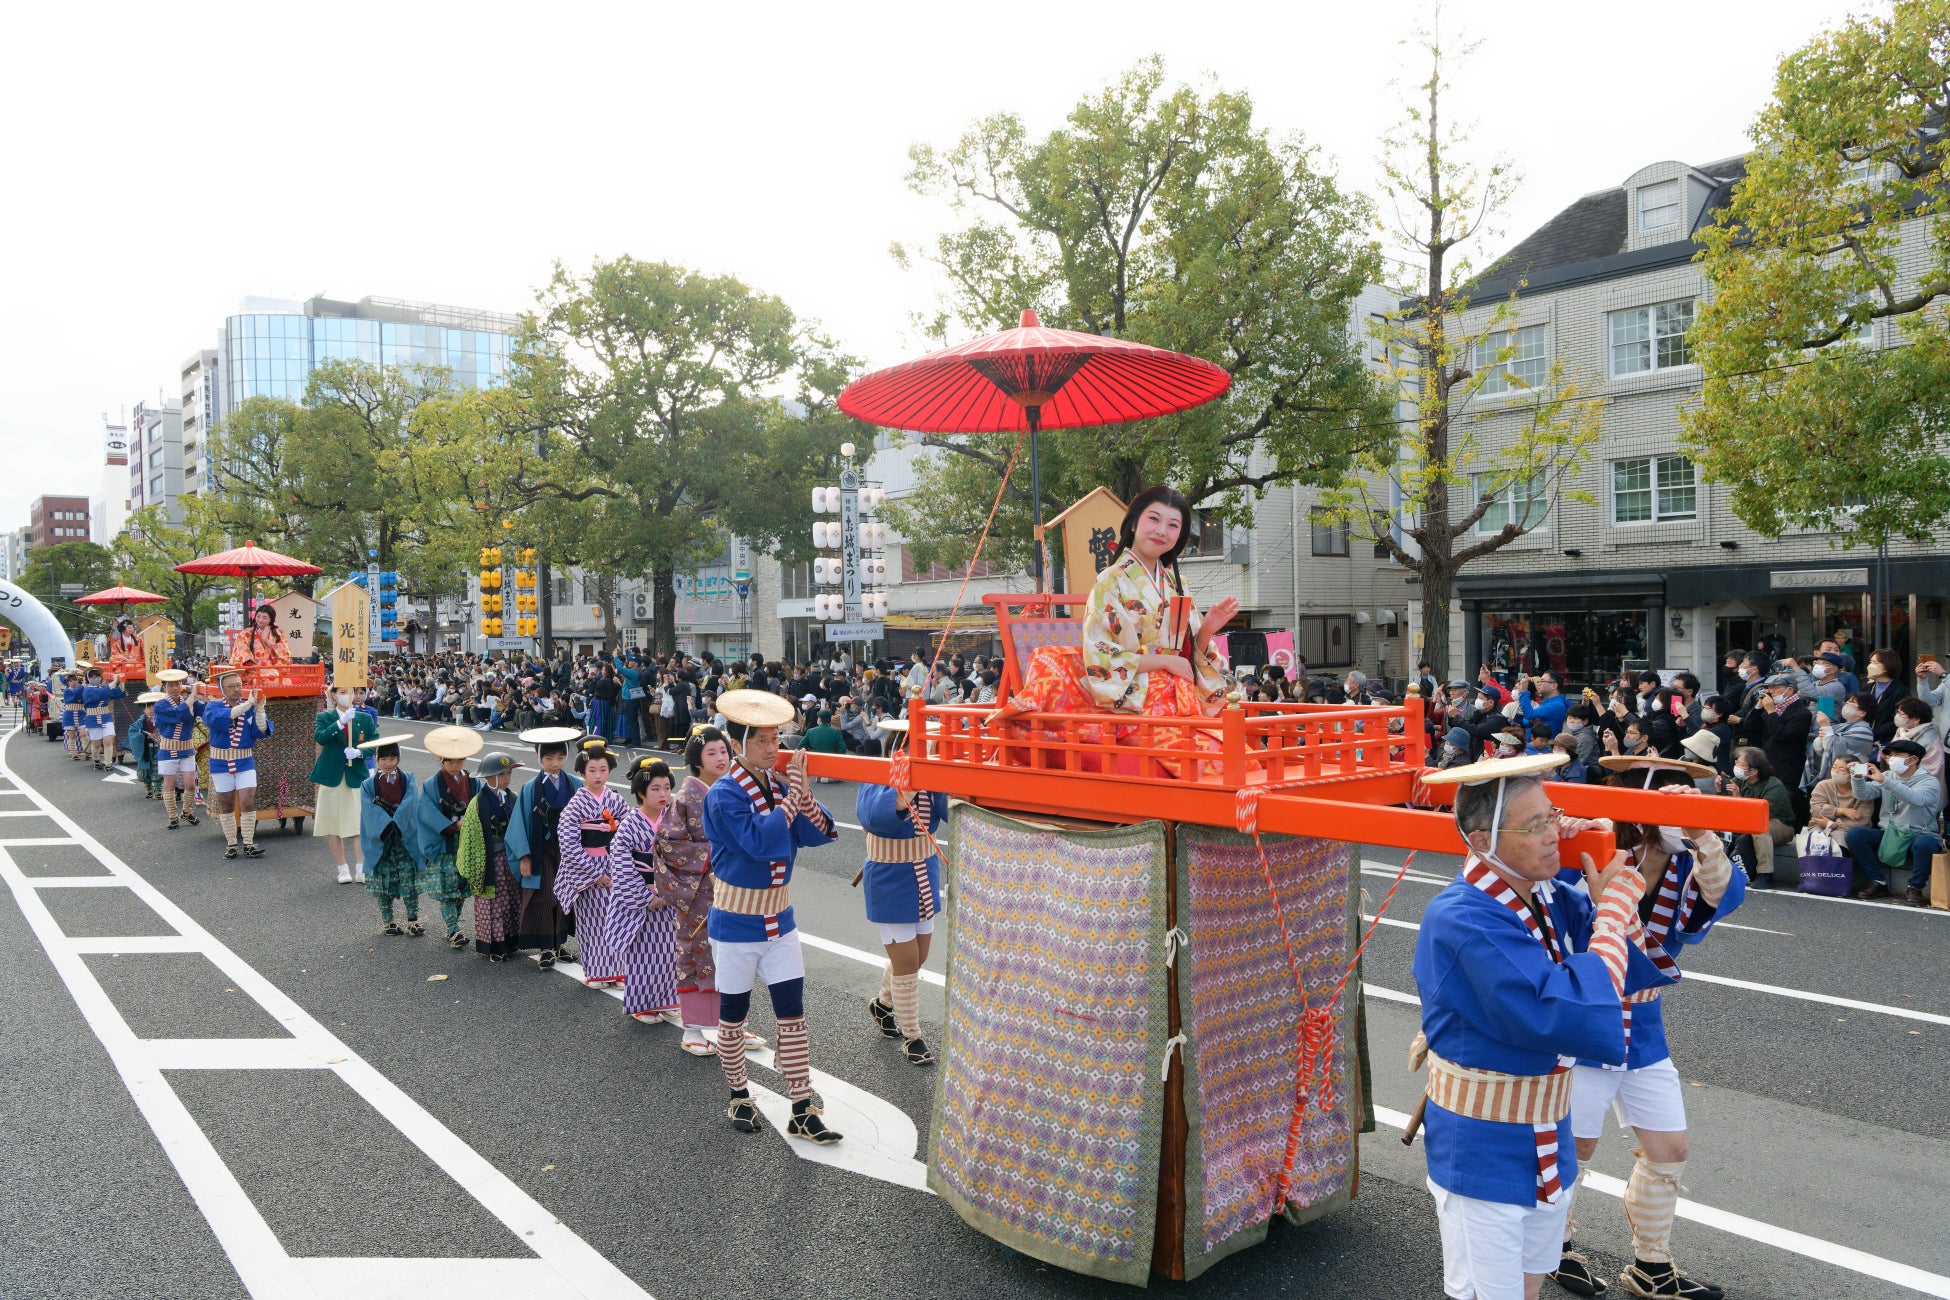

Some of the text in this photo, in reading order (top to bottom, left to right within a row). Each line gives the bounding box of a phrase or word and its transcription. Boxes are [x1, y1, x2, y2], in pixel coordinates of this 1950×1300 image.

[289, 607, 303, 640] 光姫
[149, 644, 160, 673] 喜代姫
[338, 622, 356, 664] 光姫
